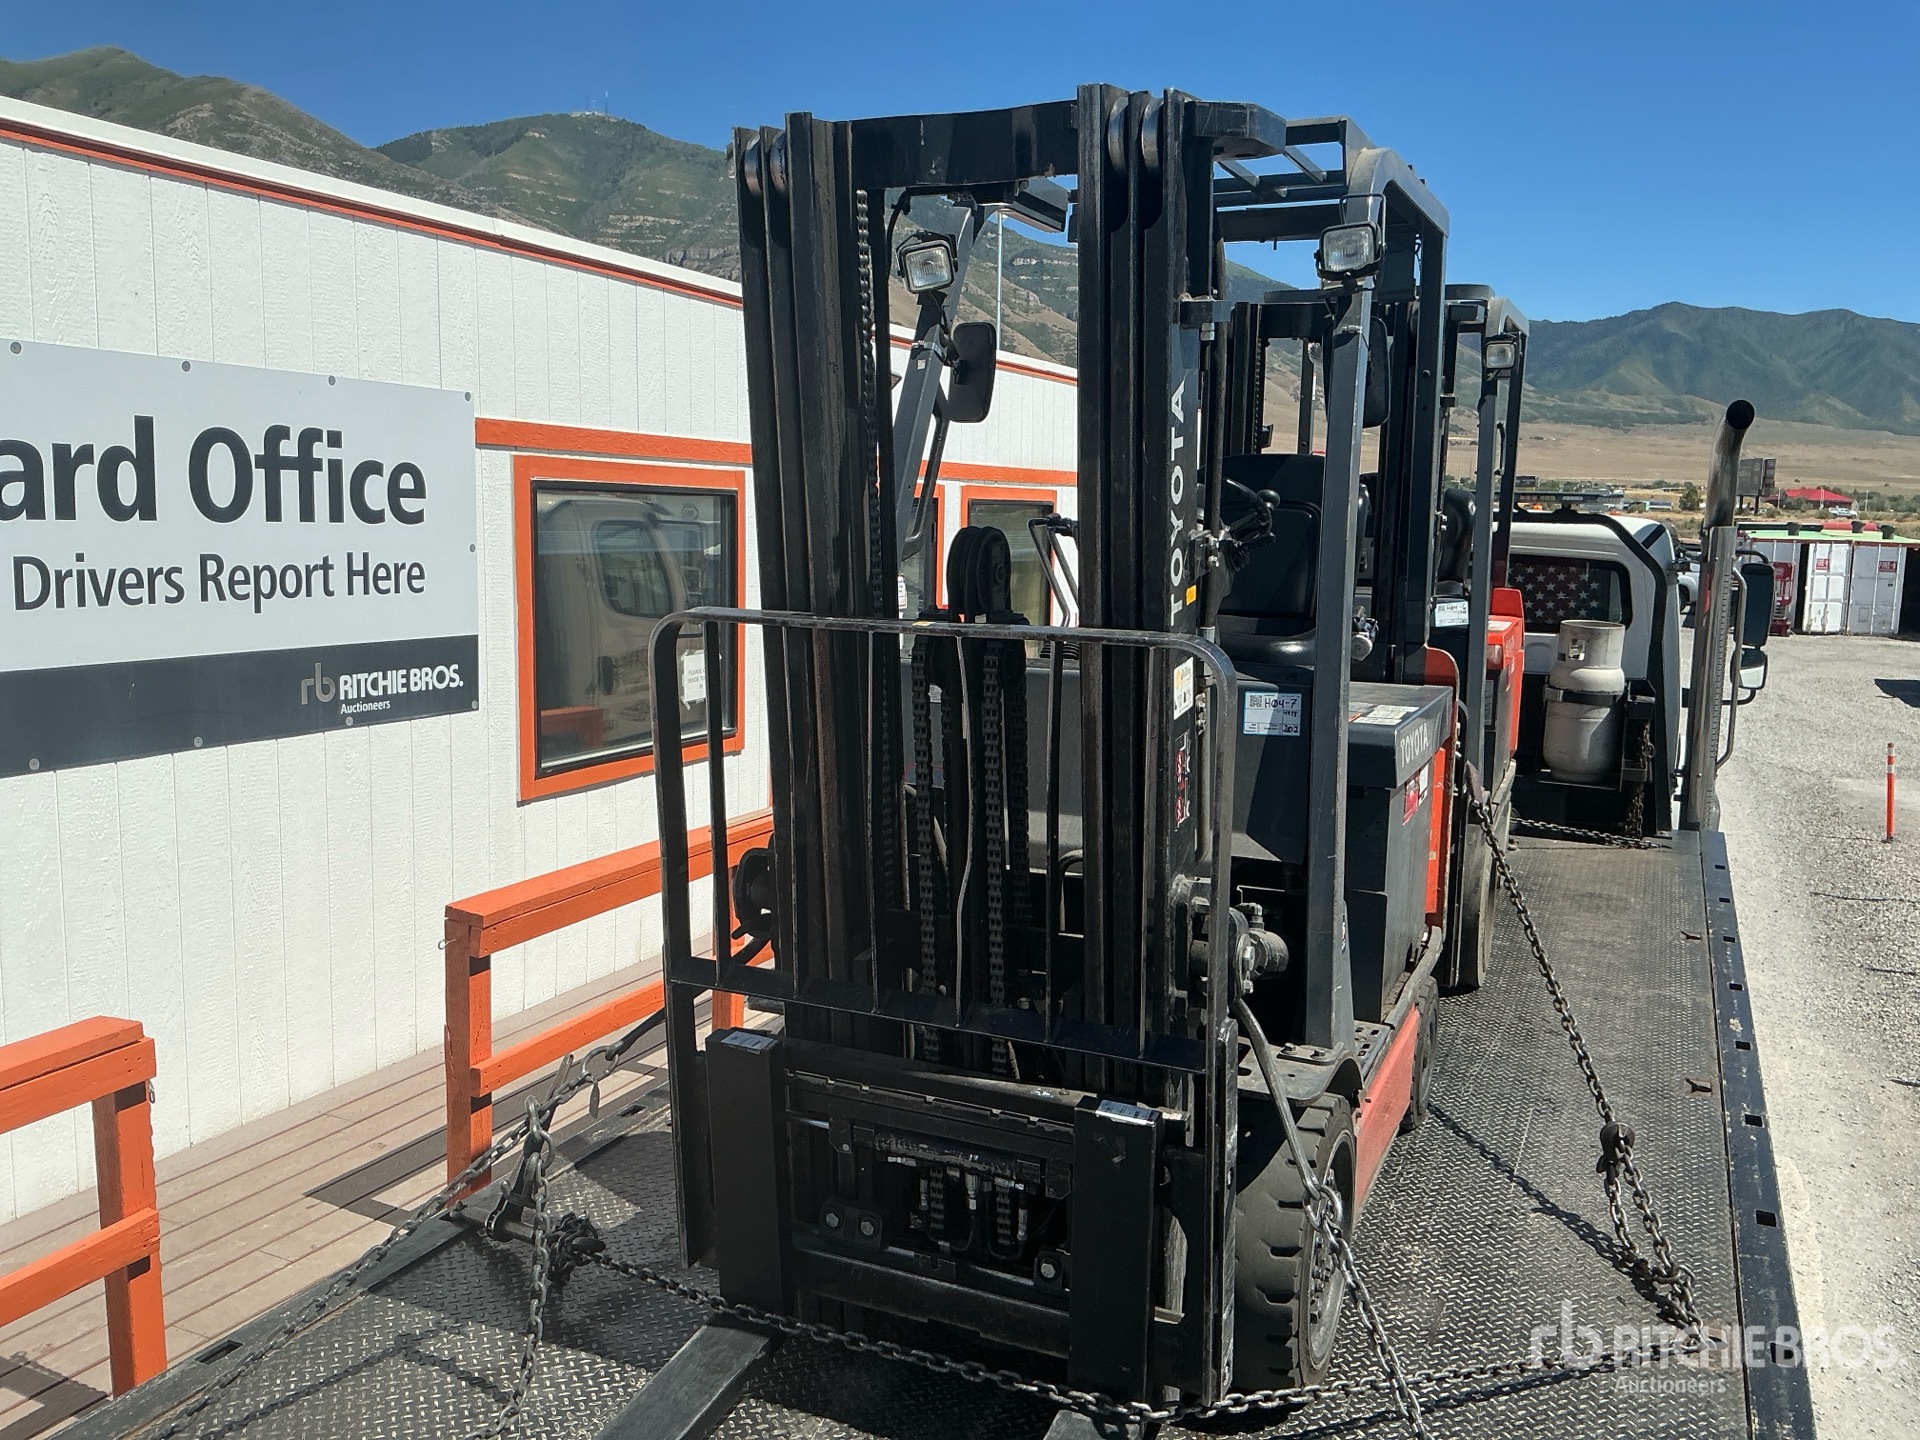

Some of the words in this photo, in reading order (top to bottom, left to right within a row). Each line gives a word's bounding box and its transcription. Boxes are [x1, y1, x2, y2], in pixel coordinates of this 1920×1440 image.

[188, 424, 428, 525] Office
[1170, 381, 1186, 626] TOYOTA
[13, 553, 184, 611] Drivers
[199, 553, 334, 613] Report
[347, 552, 425, 596] Here
[339, 667, 407, 700] RITCHIE
[409, 663, 464, 692] BROS.
[340, 700, 391, 714] Auctioneers
[1400, 723, 1429, 768] TOYOTA
